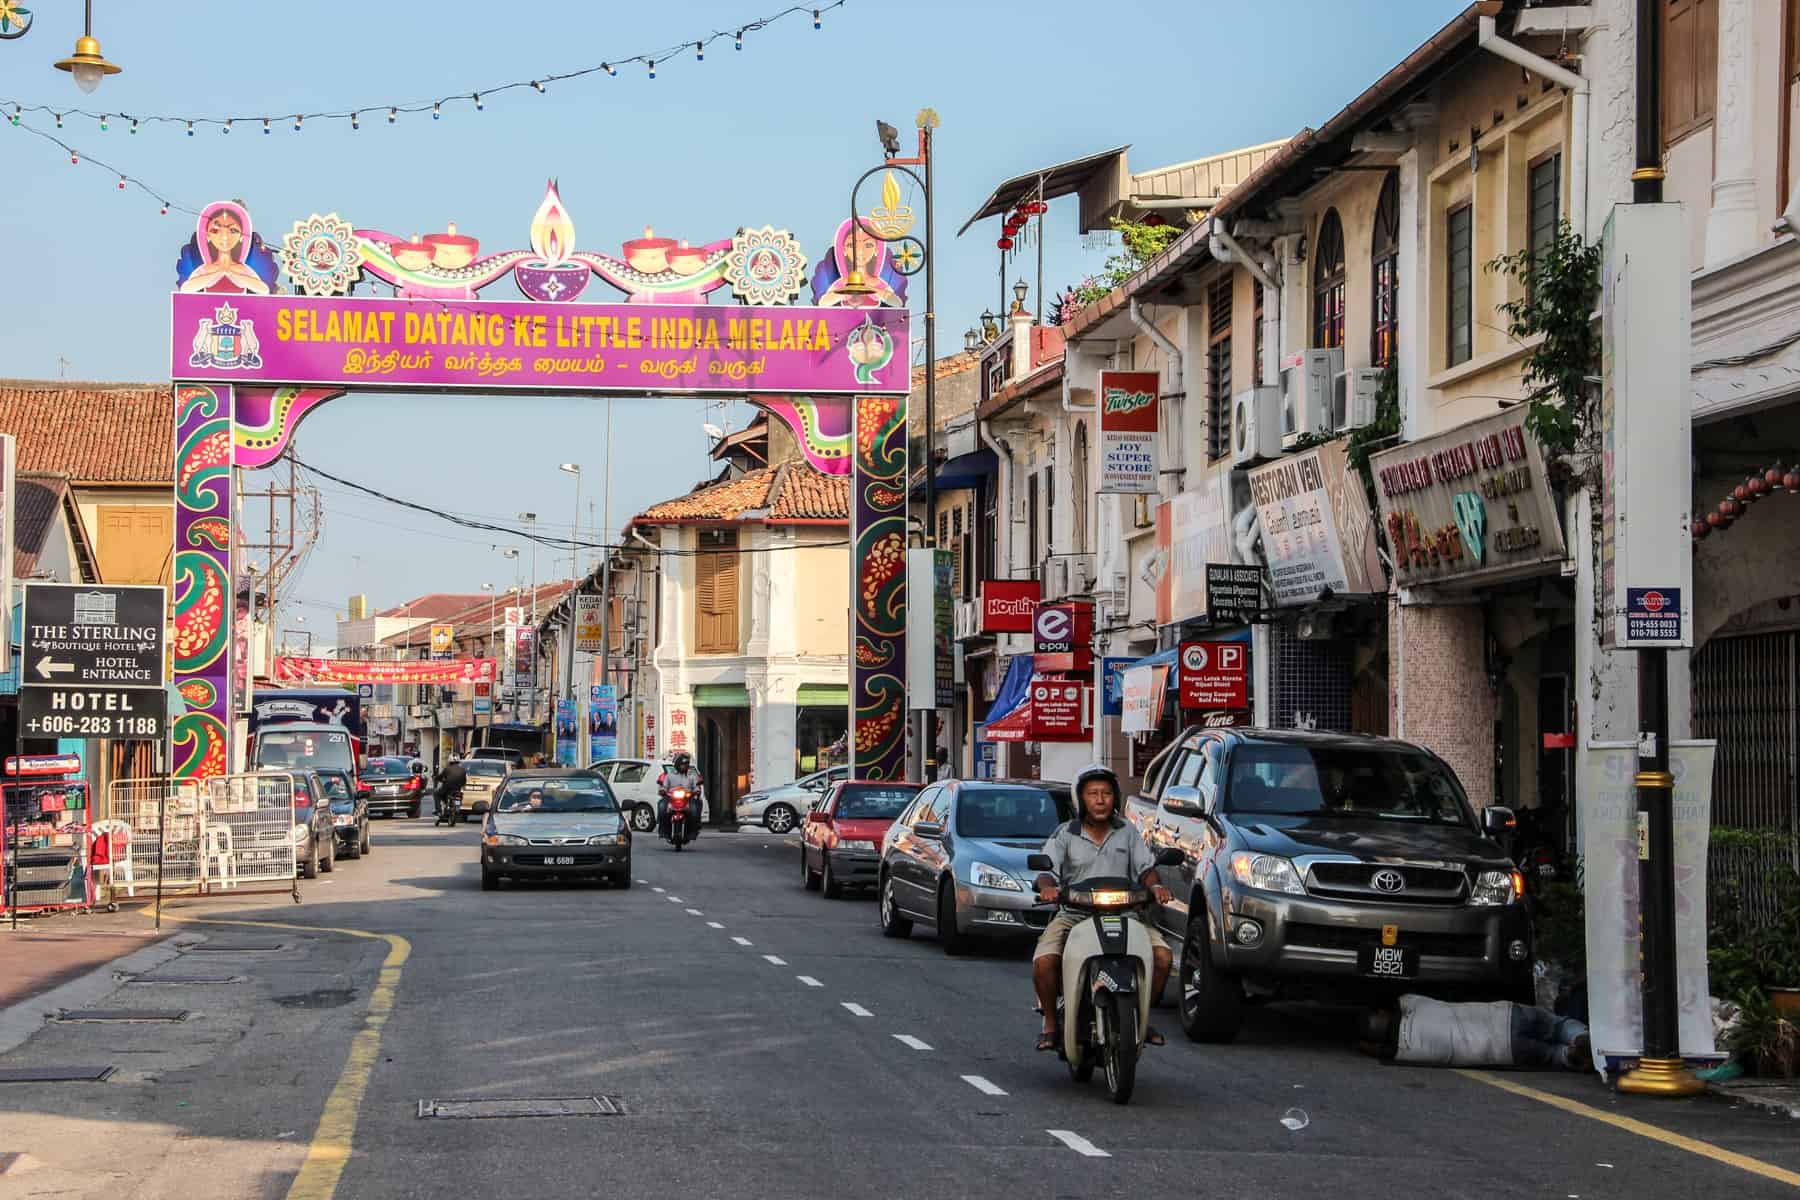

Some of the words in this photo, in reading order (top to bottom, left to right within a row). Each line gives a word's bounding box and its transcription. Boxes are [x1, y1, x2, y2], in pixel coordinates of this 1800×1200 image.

[276, 309, 395, 344] SELAMAT
[404, 312, 503, 346] DATANG
[513, 315, 547, 347] KE
[556, 316, 642, 349] LITTLE
[651, 318, 720, 350] INDIA
[729, 318, 831, 351] MELAKA
[1106, 391, 1153, 412] Twister
[1116, 443, 1141, 451] JOY
[1107, 453, 1151, 462] SUPER
[1107, 463, 1152, 472] STORE
[1251, 464, 1299, 506] RESTORAN
[1297, 455, 1323, 493] VENI
[32, 625, 67, 639] THE
[72, 625, 157, 641] STERLING
[1659, 629, 1677, 637] 5555
[96, 657, 138, 668] HOTEL
[1222, 648, 1238, 667] P
[82, 669, 151, 680] ENTRANCE
[52, 692, 133, 711] HOTEL
[26, 716, 111, 733] +606-283
[116, 717, 157, 734] 1188
[1202, 711, 1235, 727] Tune
[671, 709, 688, 755] 南華
[1375, 947, 1403, 962] MBW
[1373, 960, 1403, 975] 9921
